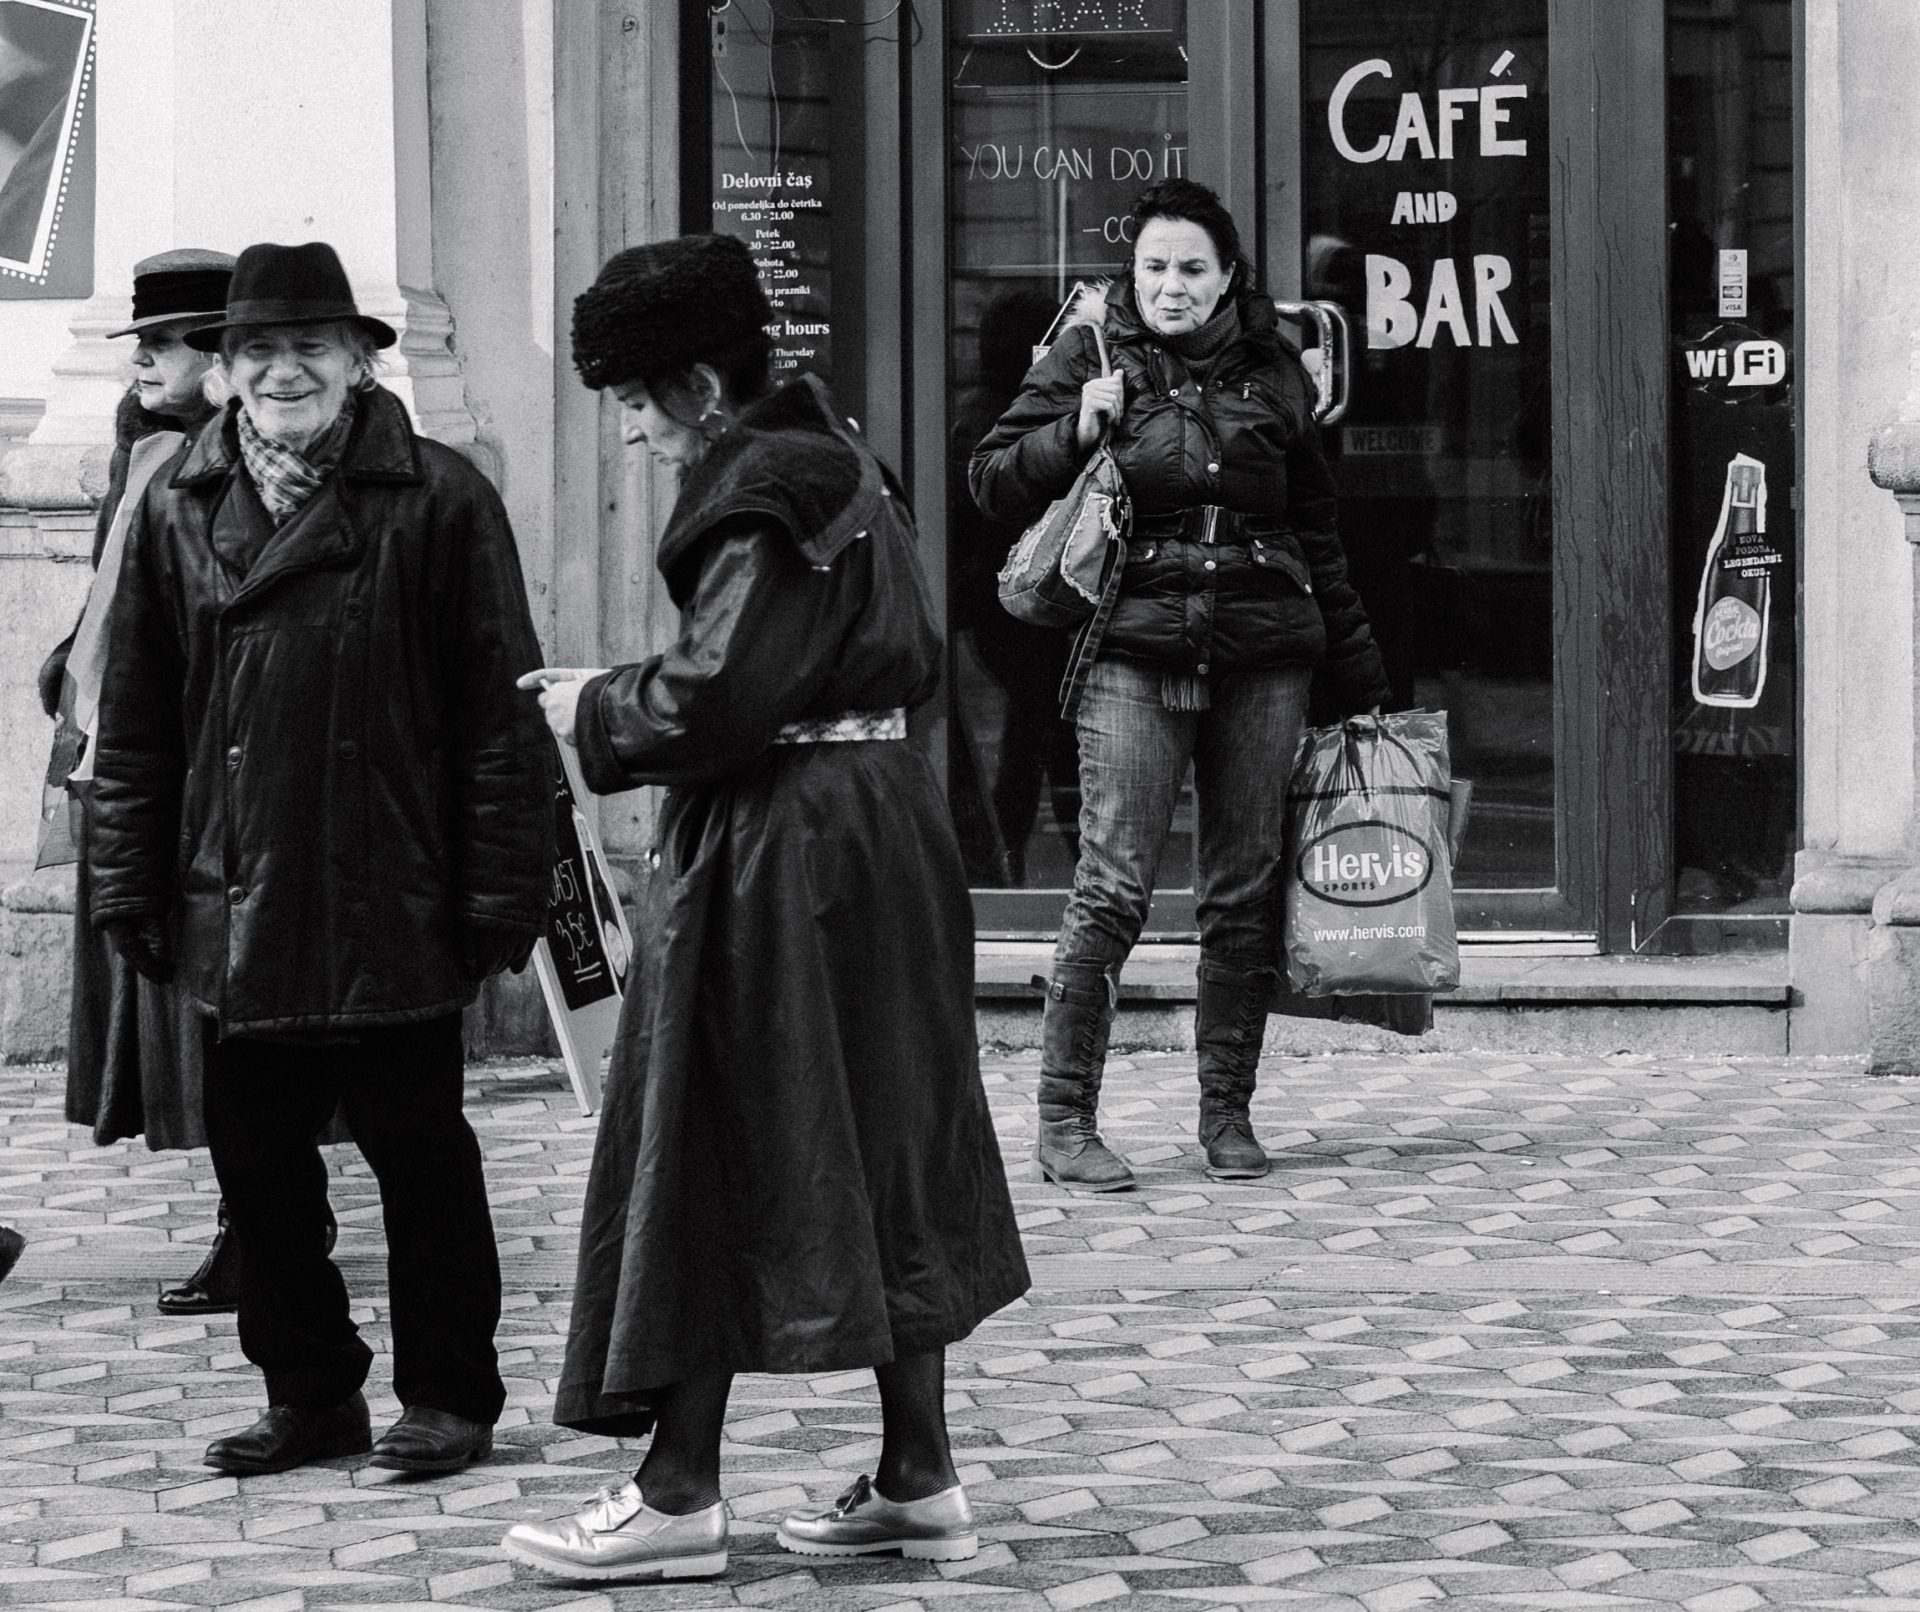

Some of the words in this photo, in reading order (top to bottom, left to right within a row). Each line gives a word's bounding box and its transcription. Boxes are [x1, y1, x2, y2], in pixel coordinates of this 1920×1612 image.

[1328, 50, 1528, 163] CAFÉ
[961, 144, 1023, 181] YOU
[1033, 146, 1093, 181] CAN
[1110, 147, 1153, 181] DO
[722, 172, 782, 189] Delovni
[712, 201, 726, 210] Od
[727, 200, 776, 212] ponedeljka
[777, 199, 789, 208] do
[790, 198, 823, 208] četrtka
[1391, 191, 1458, 225] AND
[741, 212, 761, 221] 6.30
[755, 229, 781, 239] Petek
[753, 258, 784, 267] Sobota
[764, 287, 773, 295] in
[775, 285, 811, 297] prazniki
[769, 299, 784, 307] rto
[1365, 254, 1520, 350] BAR
[1724, 303, 1742, 311] VISA
[761, 324, 782, 340] ng
[785, 319, 831, 335] hours
[774, 347, 815, 358] Thursday
[1350, 428, 1434, 452] WELCOME
[1739, 534, 1764, 544] NOVA
[1724, 554, 1783, 569] LEGENDARNI
[1741, 567, 1771, 578] OKUS.
[1313, 843, 1424, 887] Hervis
[1323, 881, 1376, 893] SPORTS
[1313, 924, 1425, 942] www.hervis.com
